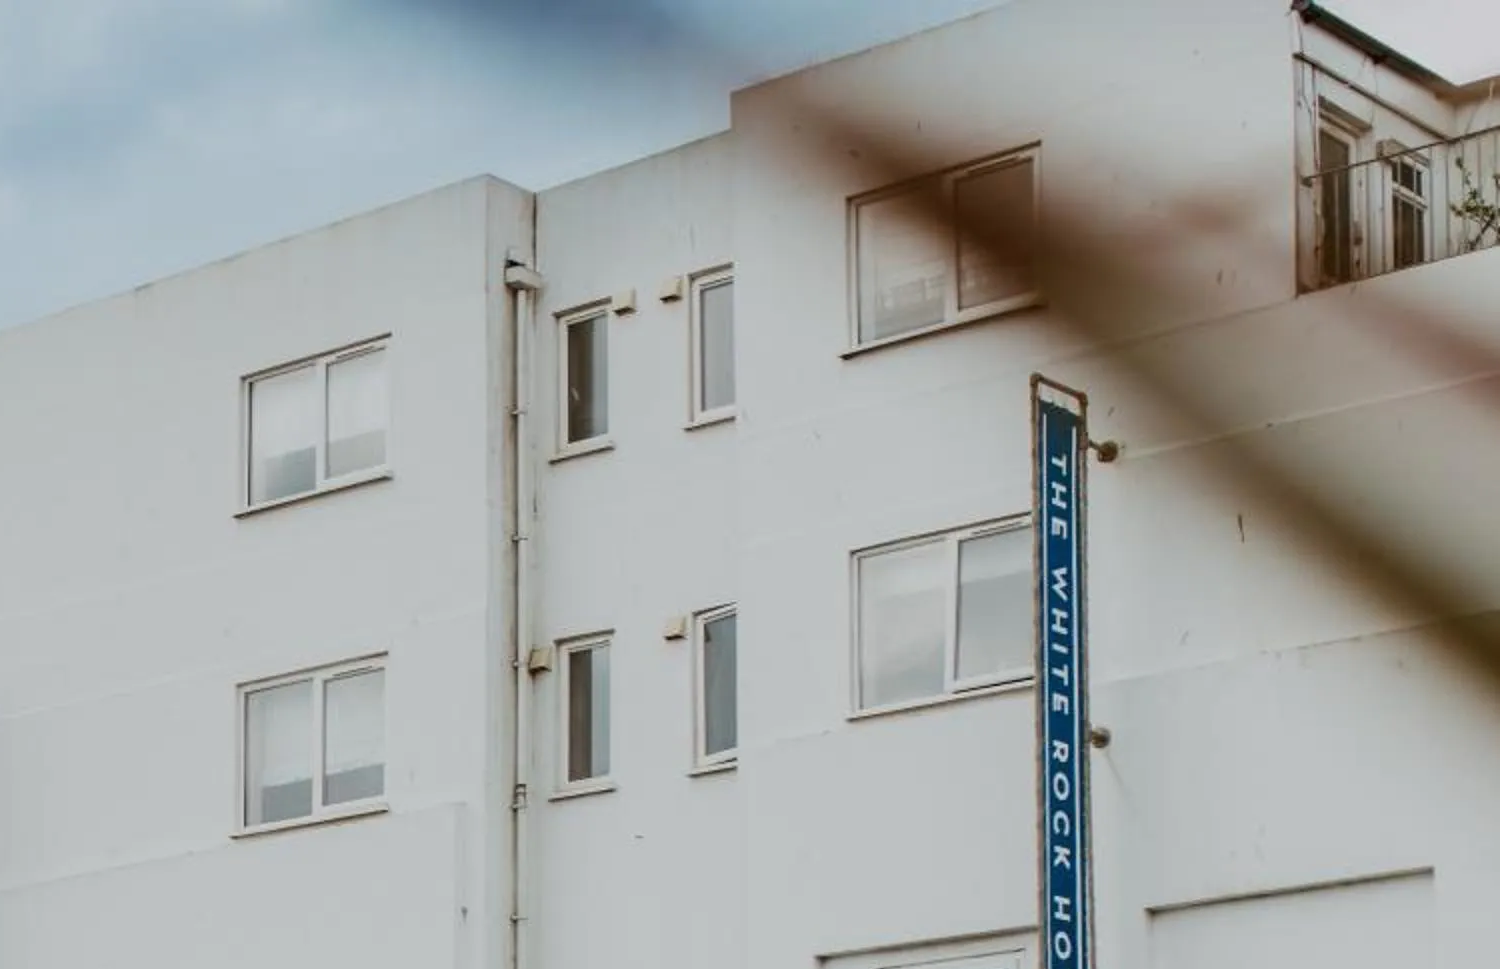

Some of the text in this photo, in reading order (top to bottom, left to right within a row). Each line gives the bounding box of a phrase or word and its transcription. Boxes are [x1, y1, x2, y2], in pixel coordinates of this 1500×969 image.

[1051, 455, 1067, 539] THE
[1052, 567, 1069, 714] WHITE
[1053, 740, 1071, 868] ROCK
